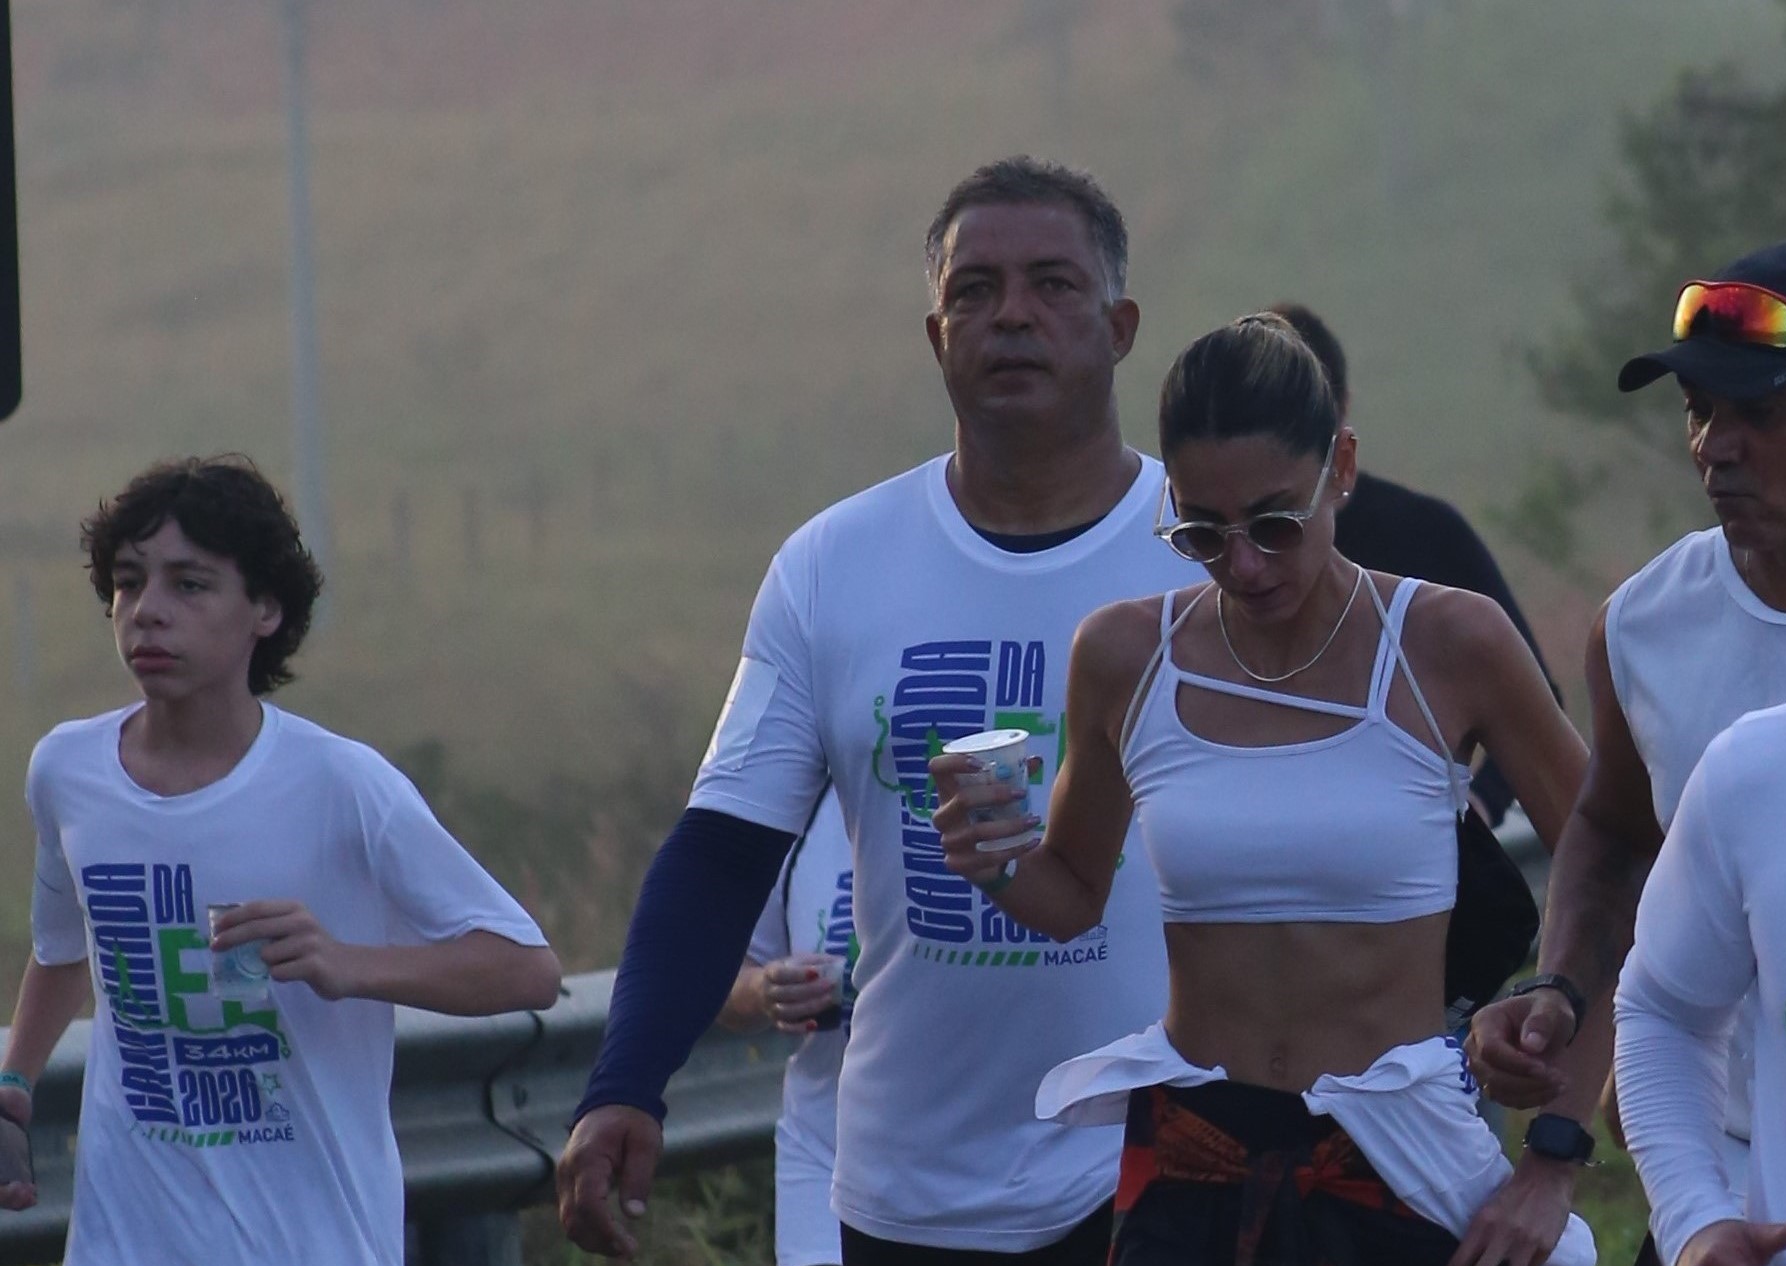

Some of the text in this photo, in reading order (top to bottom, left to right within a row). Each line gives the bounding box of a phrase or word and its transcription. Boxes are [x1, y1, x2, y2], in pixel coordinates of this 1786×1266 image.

[995, 640, 1046, 707] DA
[152, 864, 196, 923] DA
[1044, 941, 1108, 967] MACAÉ
[183, 1042, 270, 1059] 34KM
[178, 1067, 262, 1127] 2026
[237, 1126, 295, 1144] MACAÉ
